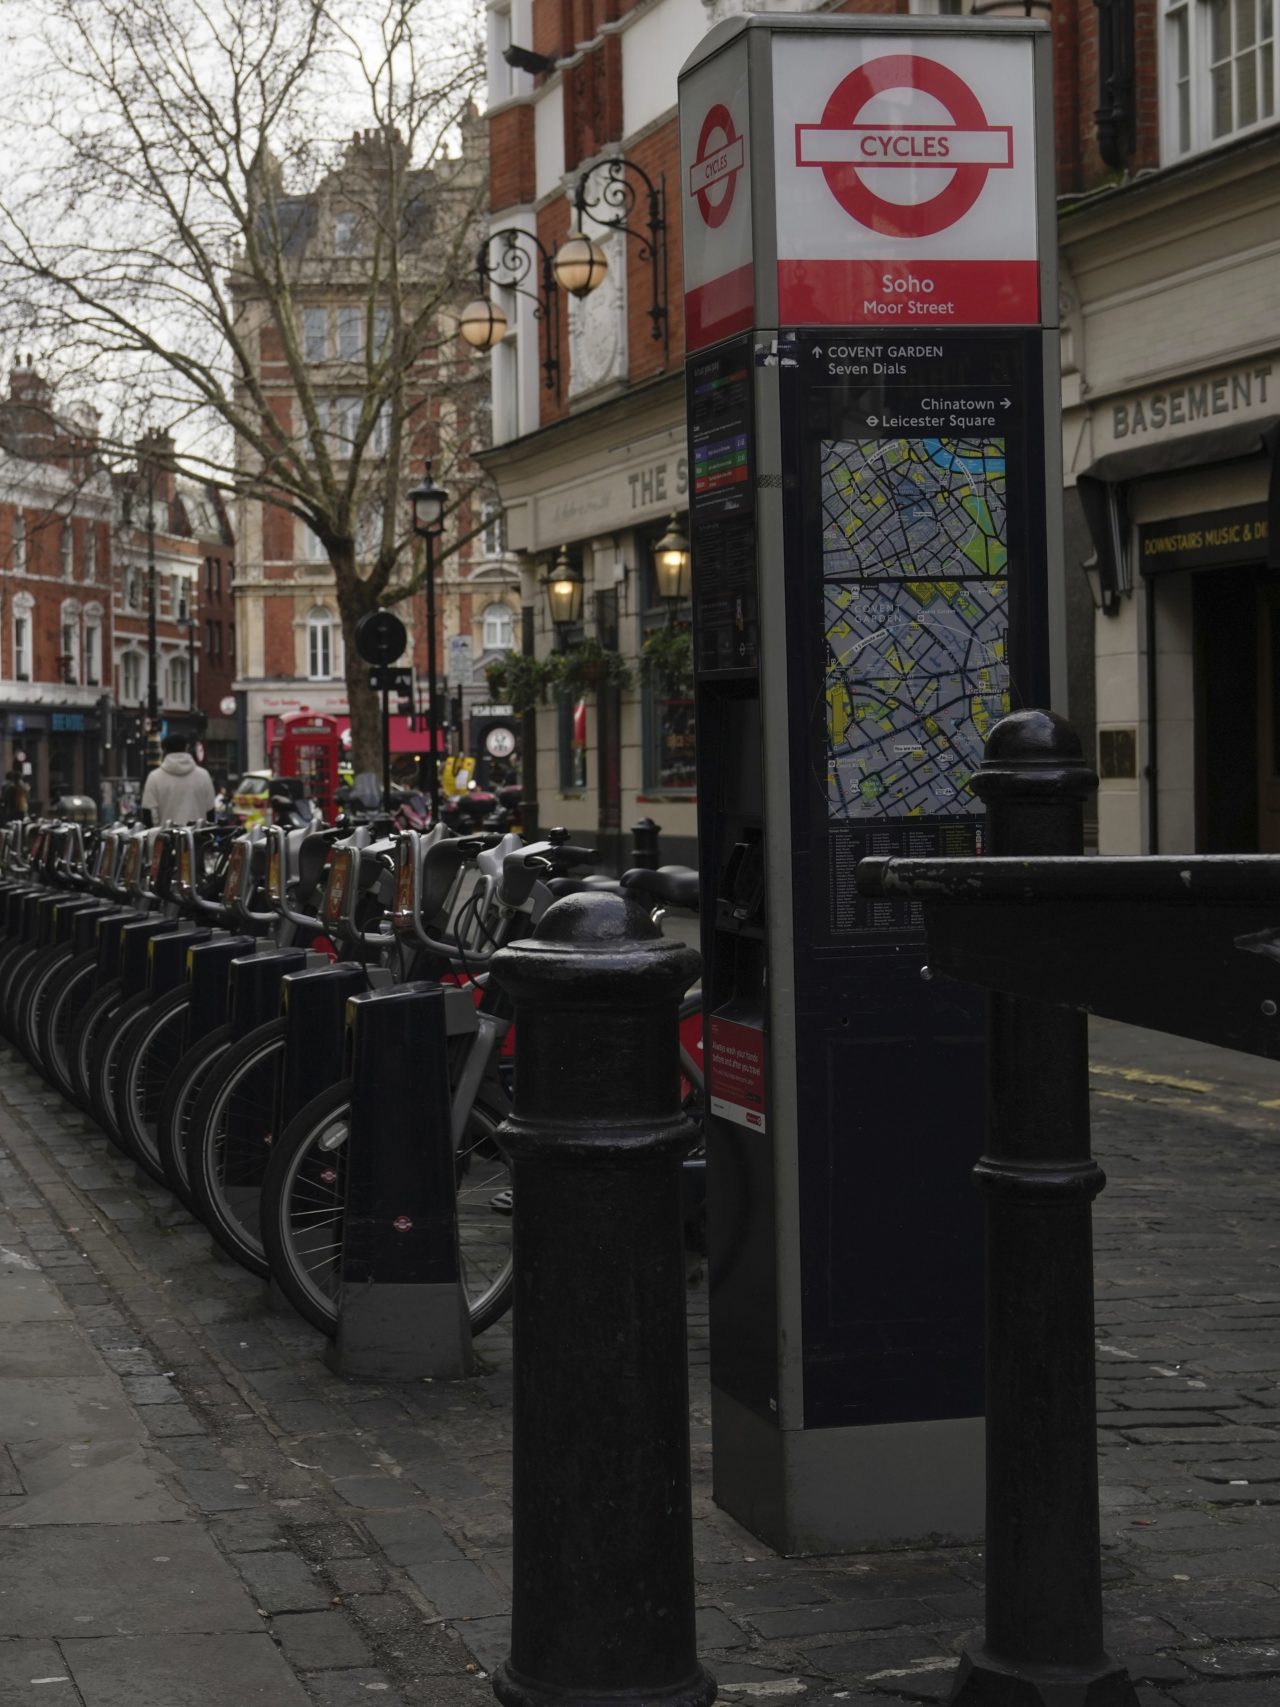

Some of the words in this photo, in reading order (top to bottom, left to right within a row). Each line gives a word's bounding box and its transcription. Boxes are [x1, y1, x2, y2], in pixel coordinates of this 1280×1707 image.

[859, 135, 950, 158] CYCLES
[705, 154, 728, 179] CYCLES
[882, 274, 935, 293] Soho
[863, 300, 904, 315] Moor
[907, 300, 955, 315] Street
[827, 345, 885, 359] COVENT
[887, 345, 944, 358] GARDEN
[827, 363, 869, 376] Seven
[872, 362, 907, 375] Dials
[920, 398, 995, 411] Chinatown
[1112, 364, 1273, 439] BASEMENT
[882, 414, 946, 428] Leicester
[948, 414, 996, 430] Square
[628, 463, 667, 509] THE
[1144, 531, 1202, 556] DOWNSTAIRS
[1204, 524, 1240, 547] MUSIC
[1242, 523, 1252, 542] &
